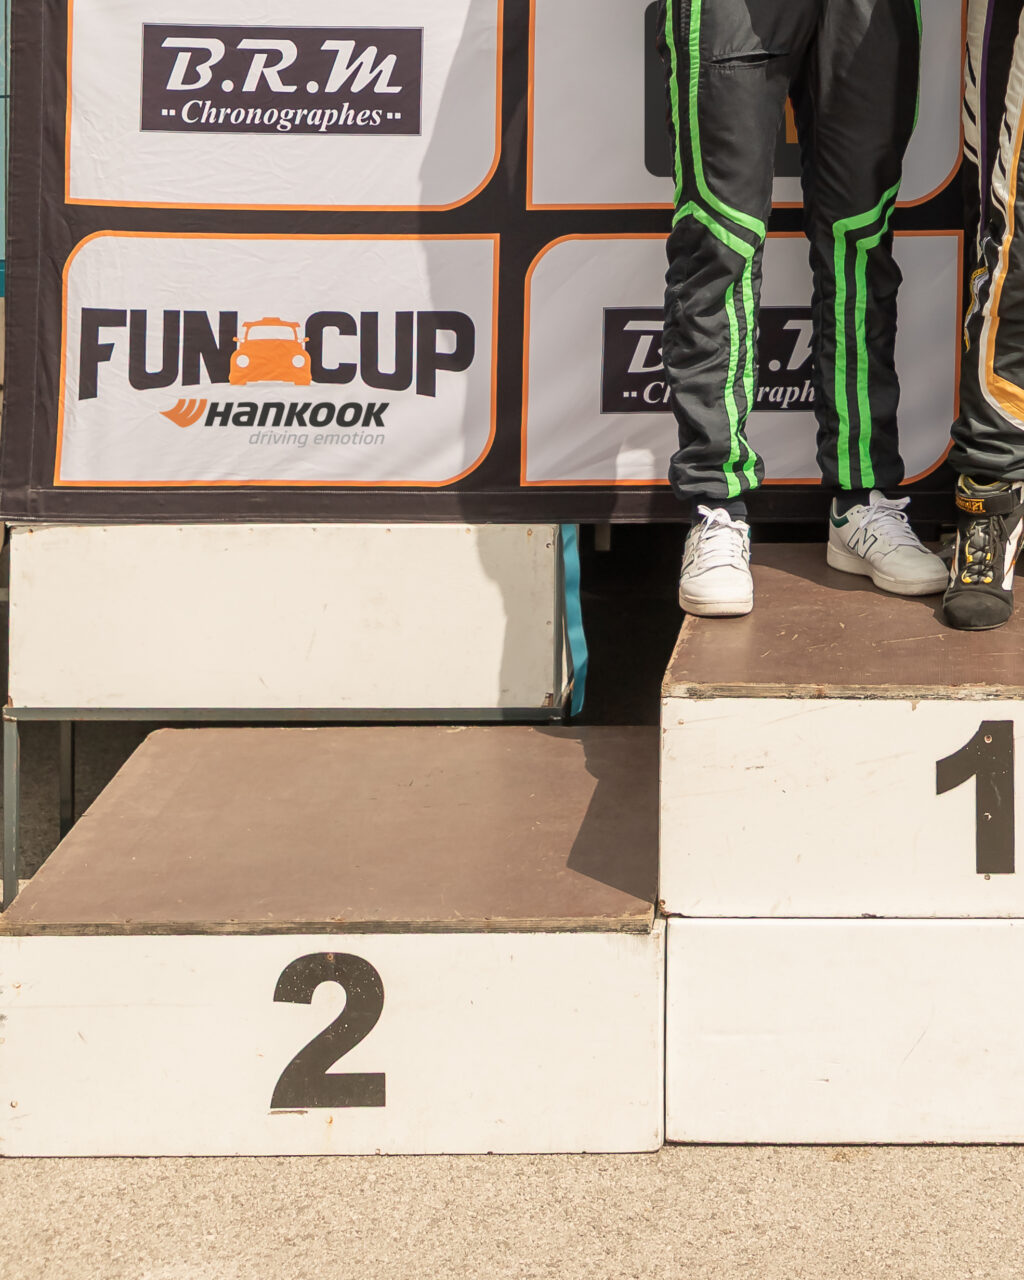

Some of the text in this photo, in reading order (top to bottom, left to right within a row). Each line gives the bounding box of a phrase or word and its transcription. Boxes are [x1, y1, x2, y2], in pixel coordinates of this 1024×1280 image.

[181, 99, 383, 132] Chronographes
[78, 307, 476, 401] FUN CUP
[248, 430, 386, 449] driving emotion
[936, 722, 1015, 874] 1
[272, 953, 386, 1108] 2
